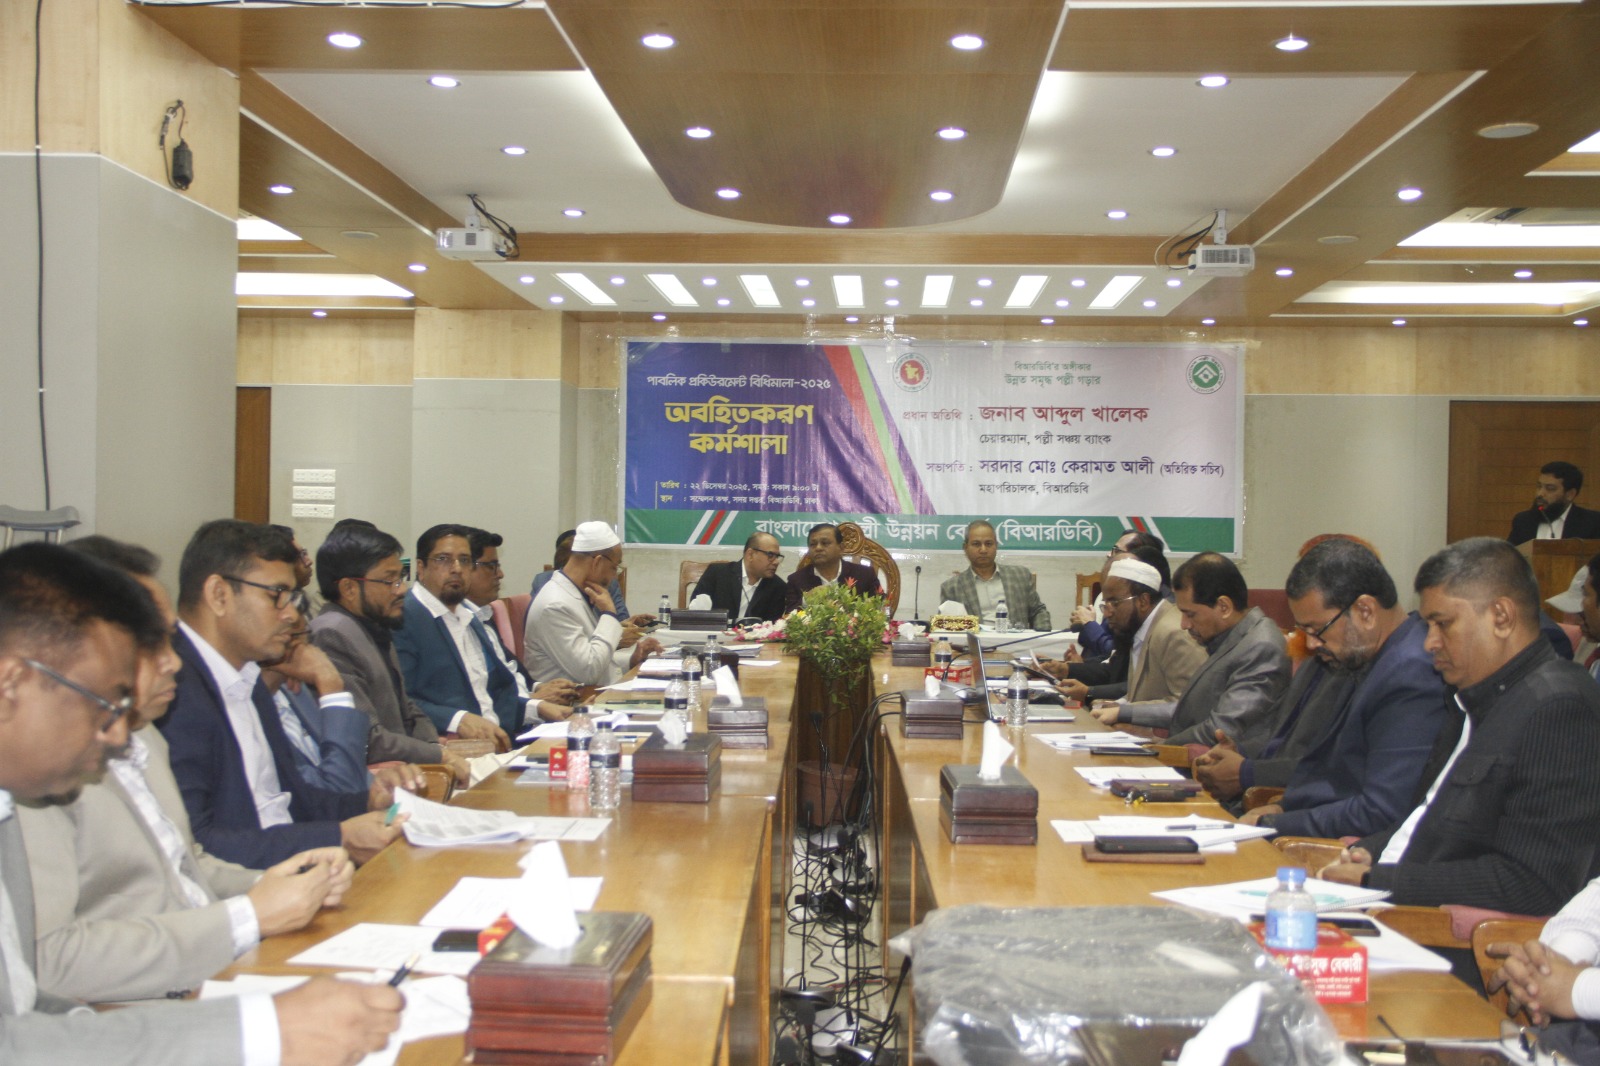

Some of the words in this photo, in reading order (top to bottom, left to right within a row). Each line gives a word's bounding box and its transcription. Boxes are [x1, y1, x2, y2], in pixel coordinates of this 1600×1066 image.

[647, 373, 687, 387] পাবলিক
[688, 374, 748, 388] প্রকিউরমেন্ট
[749, 374, 832, 389] বিধিমালা-২০২৫
[1004, 373, 1028, 386] উন্নত
[1029, 374, 1053, 388] সমৃদ্ধ
[1056, 372, 1075, 386] পল্লী
[664, 394, 815, 425] অবহিতকরণ
[902, 409, 928, 422] প্রধান
[931, 408, 963, 421] অতিথি
[978, 406, 1026, 423] জনাব
[1031, 406, 1086, 427] আব্দুল
[1091, 406, 1151, 424] খালেক
[688, 424, 789, 455] কর্মশালা
[1034, 430, 1054, 445] পল্লী
[1056, 433, 1082, 445] সঞ্চয়
[1084, 433, 1112, 445] ব্যাংক
[925, 460, 966, 473] সভাপতি
[978, 459, 1023, 475] সরদার
[1061, 459, 1117, 475] কেরামত
[1120, 456, 1156, 475] আলী
[1159, 462, 1198, 477] (অতিরিক্ত
[1200, 463, 1225, 478] সচিব)
[660, 480, 680, 490] তারিখ
[689, 482, 700, 490] ২২
[978, 481, 1040, 496] মহাপরিচালক,
[1043, 481, 1090, 494] বিআরডিবি
[886, 517, 941, 544] উন্নয়ন
[995, 518, 1103, 547] (বিআরডিবি)
